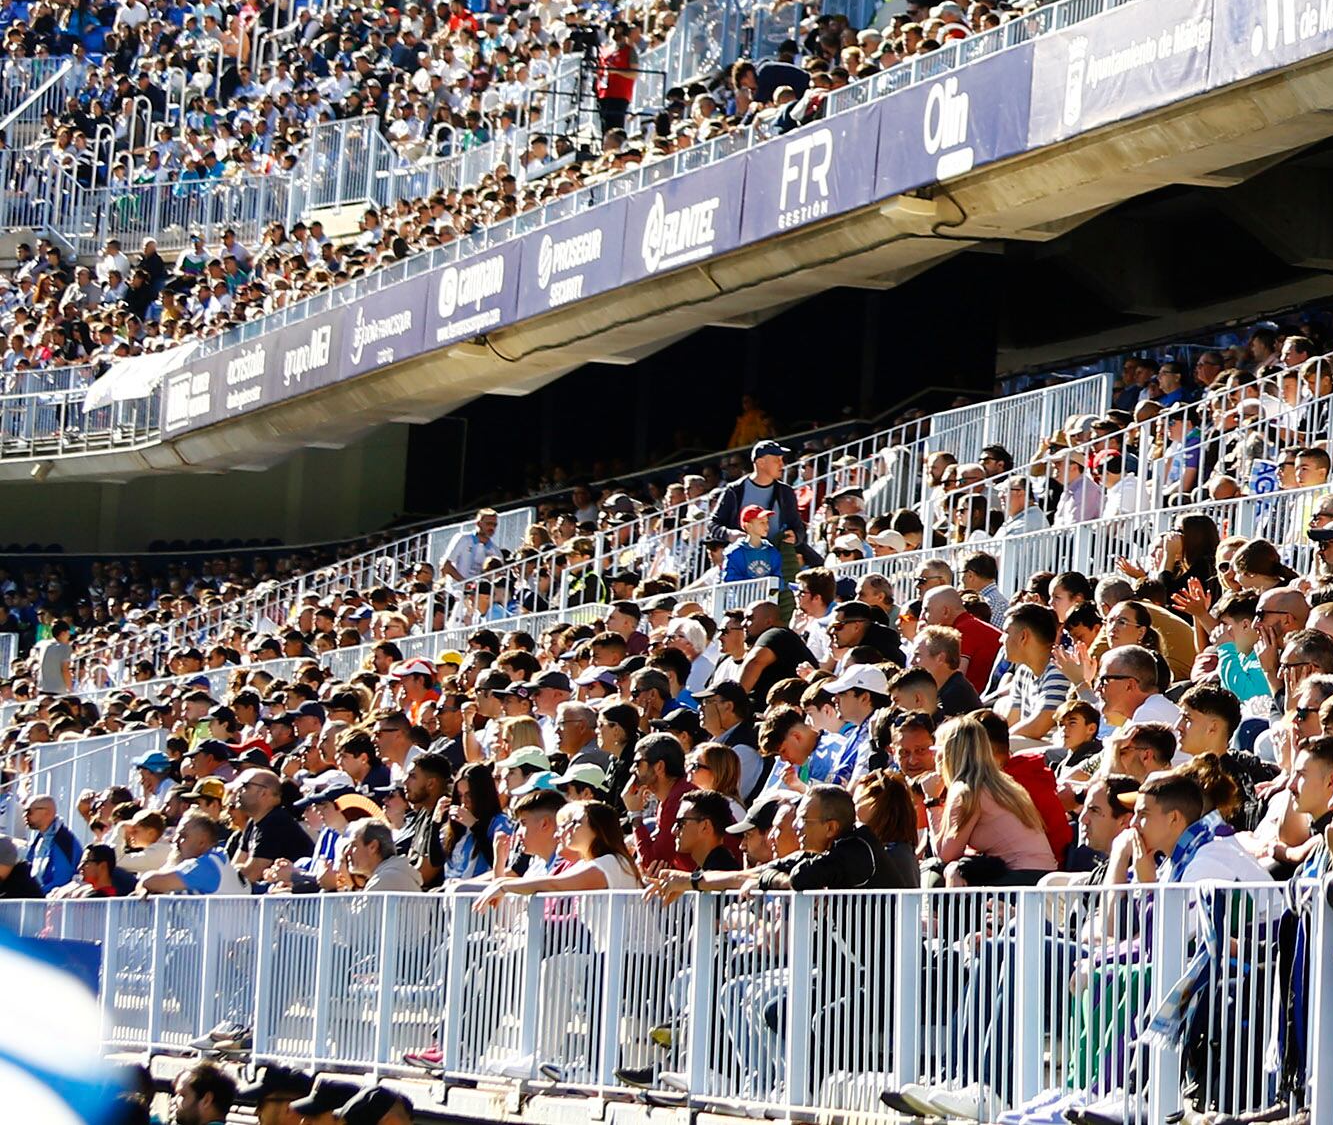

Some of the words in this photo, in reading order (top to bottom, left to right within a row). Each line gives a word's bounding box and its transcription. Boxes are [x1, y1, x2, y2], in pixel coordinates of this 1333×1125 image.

[1300, 7, 1318, 40] de
[1086, 37, 1158, 89] Ayuntamiento
[1158, 30, 1173, 60] de
[777, 200, 829, 230] GESTIÓN
[552, 229, 603, 274] PROSEGUR
[549, 274, 584, 308] SECURITY
